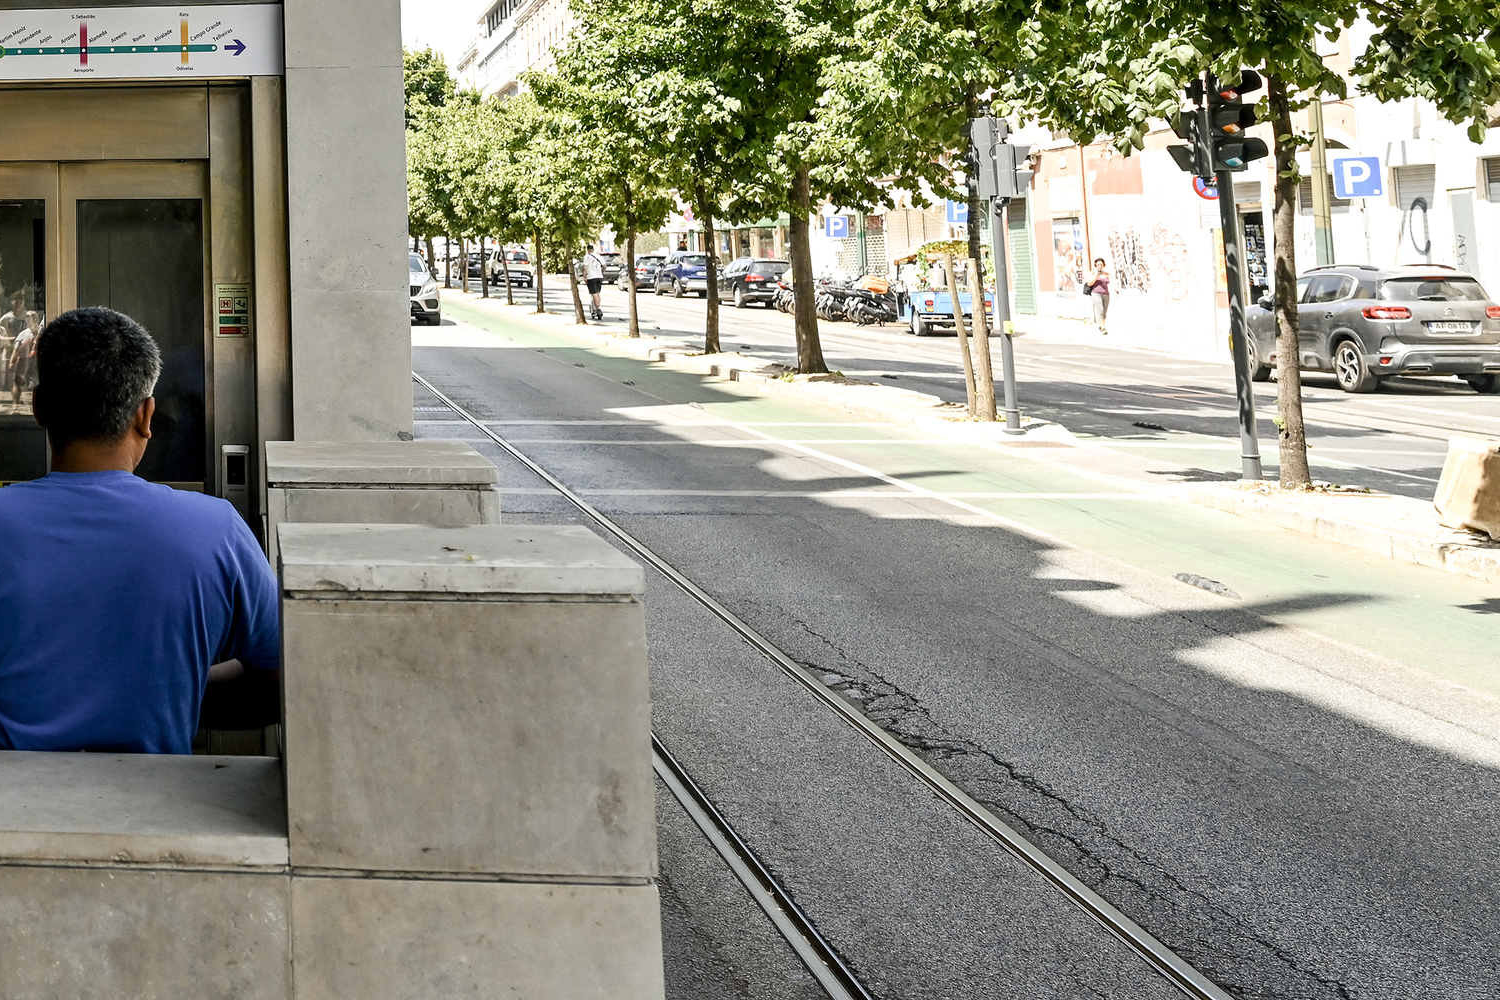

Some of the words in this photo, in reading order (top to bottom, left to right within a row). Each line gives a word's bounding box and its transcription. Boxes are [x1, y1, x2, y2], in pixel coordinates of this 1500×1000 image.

[12, 25, 27, 37] Moniz
[17, 29, 42, 46] Intendente
[60, 32, 77, 44] Arroios
[88, 30, 108, 44] Alameda
[110, 31, 128, 43] Areeiro
[132, 33, 146, 43] Roma
[153, 28, 173, 43] Alvalade
[189, 29, 206, 42] Campo
[204, 20, 222, 33] Grande
[212, 28, 233, 42] Telheiras
[39, 34, 53, 45] Anjos
[1342, 160, 1371, 195] P
[952, 201, 969, 220] P
[829, 217, 844, 236] P
